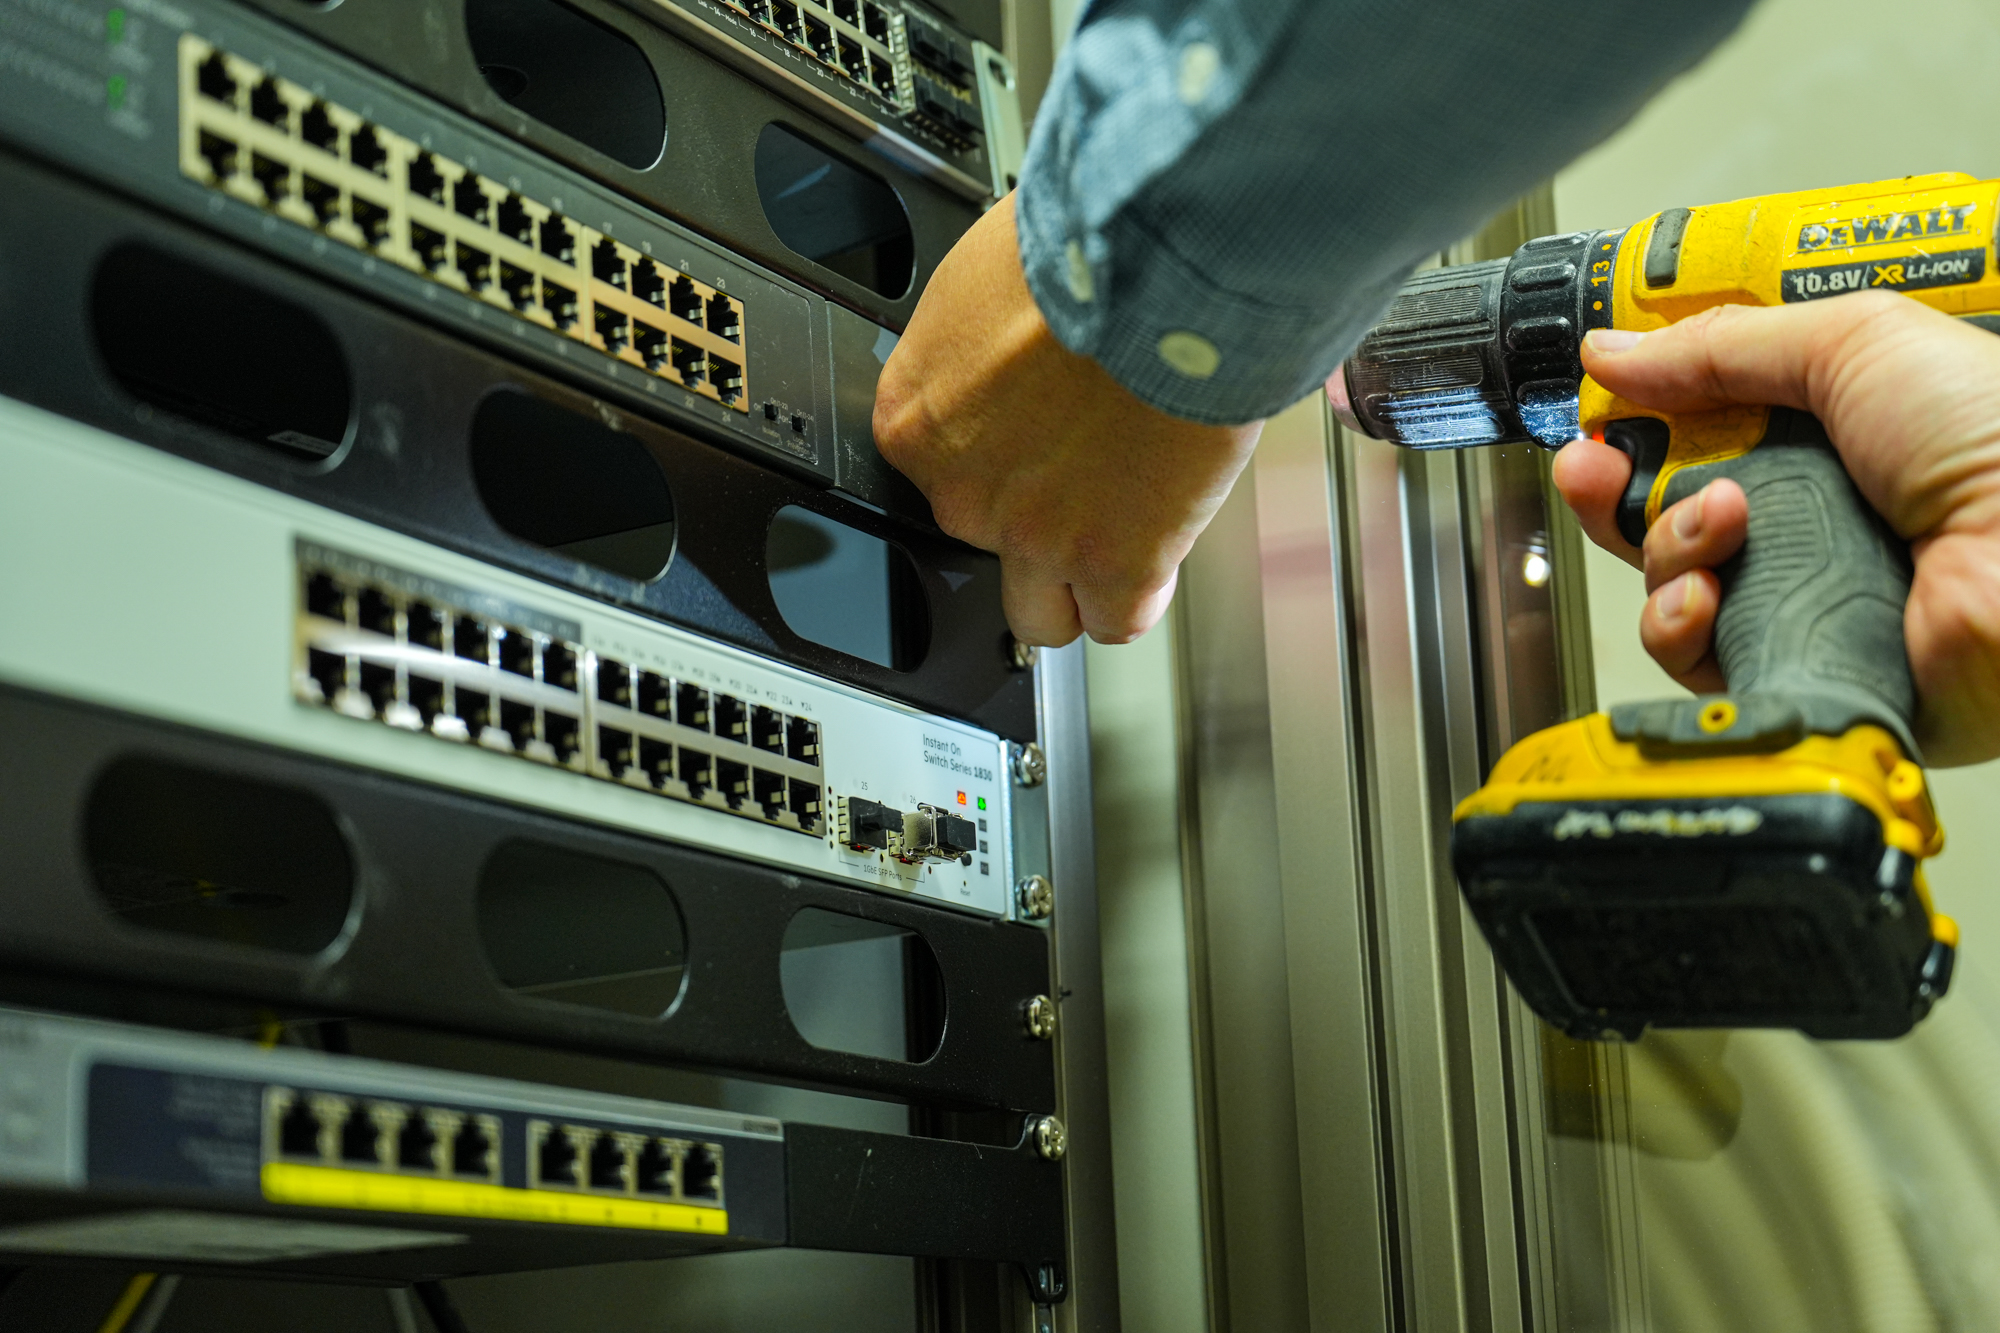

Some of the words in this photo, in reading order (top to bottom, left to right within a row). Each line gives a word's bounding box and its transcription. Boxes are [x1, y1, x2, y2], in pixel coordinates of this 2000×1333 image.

[749, 28, 757, 38] 16
[783, 48, 791, 58] 18
[816, 67, 824, 78] 20
[849, 86, 857, 97] 22
[1797, 204, 1976, 250] DEWALT
[680, 259, 689, 272] 21
[716, 276, 726, 289] 23
[1590, 260, 1610, 287] 13
[1794, 269, 1862, 294] 10.8V
[1871, 264, 1907, 287] XR
[1907, 258, 1970, 280] LI-ION
[722, 410, 731, 423] 24
[923, 733, 949, 752] Instant
[950, 742, 962, 757] On
[924, 750, 949, 769] Switch
[950, 758, 973, 776] Series
[974, 766, 993, 782] 1830
[861, 781, 868, 791] 25
[863, 864, 878, 875] 1GbE
[878, 867, 888, 877] SFP
[889, 870, 902, 881] Ports
